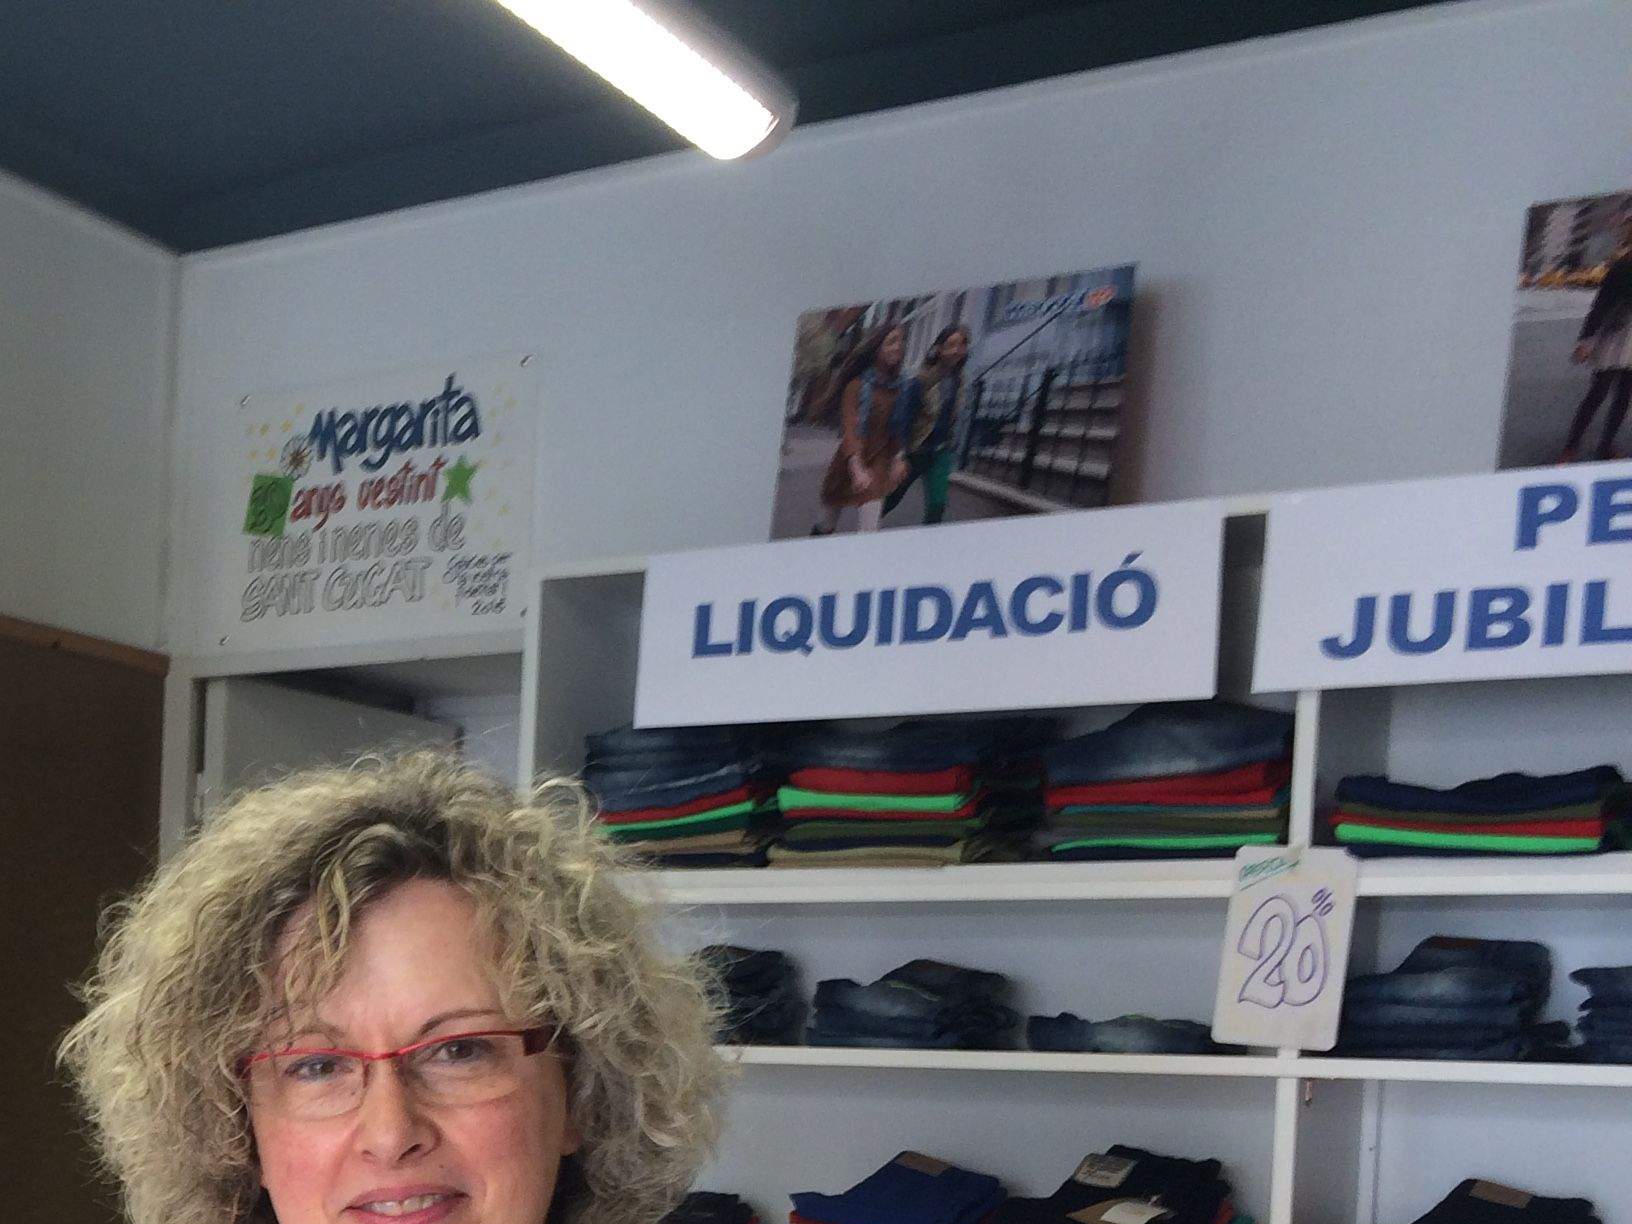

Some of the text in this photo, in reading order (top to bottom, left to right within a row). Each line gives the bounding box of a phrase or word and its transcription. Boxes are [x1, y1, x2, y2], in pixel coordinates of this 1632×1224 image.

[307, 373, 481, 475] Margarita
[429, 502, 466, 552] de
[690, 550, 1159, 659] LIQUIDACIÓ
[1320, 578, 1632, 660] JUBIL
